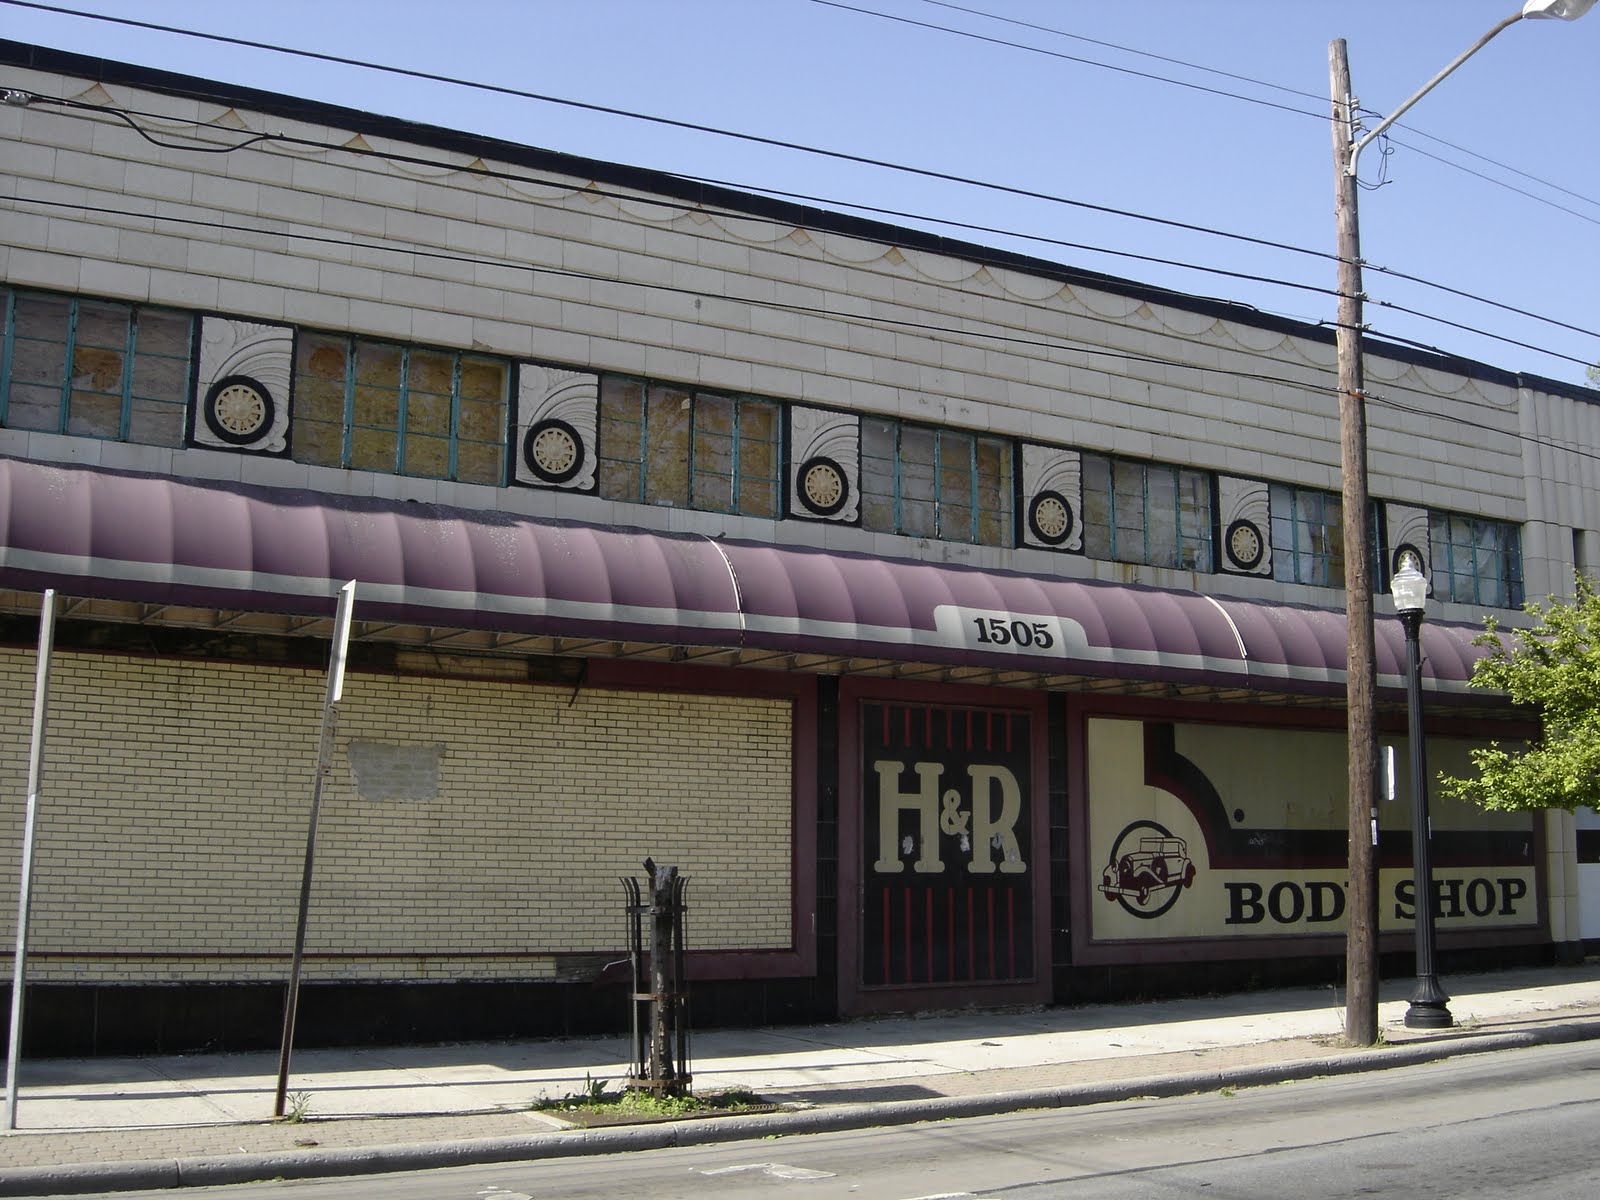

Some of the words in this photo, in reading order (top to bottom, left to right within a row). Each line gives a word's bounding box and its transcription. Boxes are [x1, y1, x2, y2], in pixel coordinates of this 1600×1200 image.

[973, 617, 1054, 649] 1505
[873, 760, 1027, 873] H&R
[1224, 881, 1350, 925] BOD
[1394, 878, 1527, 920] SHOP
